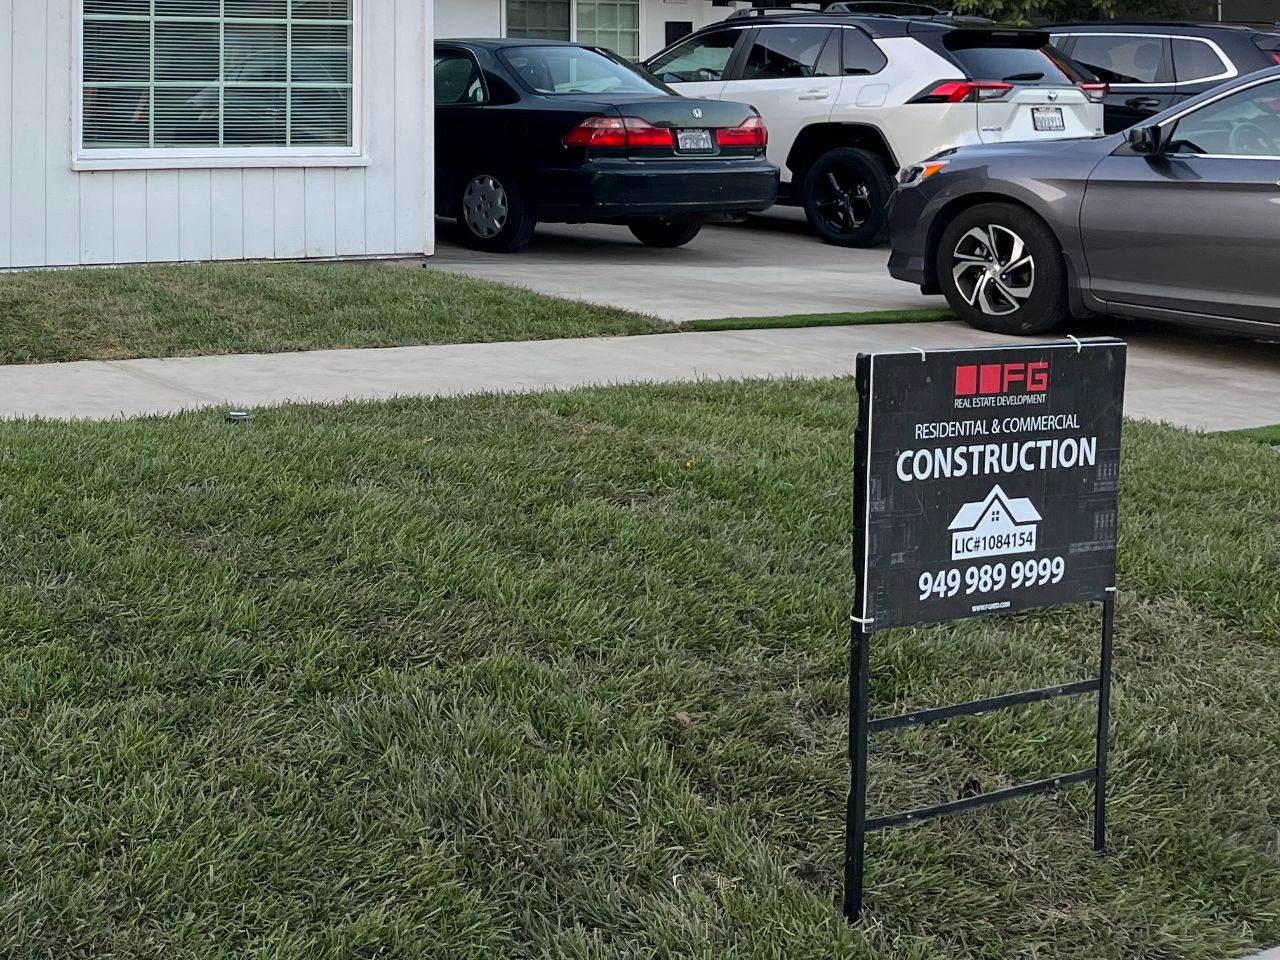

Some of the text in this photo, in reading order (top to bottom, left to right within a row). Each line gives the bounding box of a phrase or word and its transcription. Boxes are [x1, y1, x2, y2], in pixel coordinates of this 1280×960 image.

[1003, 362, 1049, 393] FG
[954, 393, 1047, 409] REAL ESTATE DEVELOPMENT
[915, 414, 1081, 439] RESIDENTIAL & COMMERCIAL
[896, 437, 1097, 482] CONSTRUCTION
[954, 531, 1033, 554] LIC#1084154
[918, 556, 1065, 601] 949 989 9999
